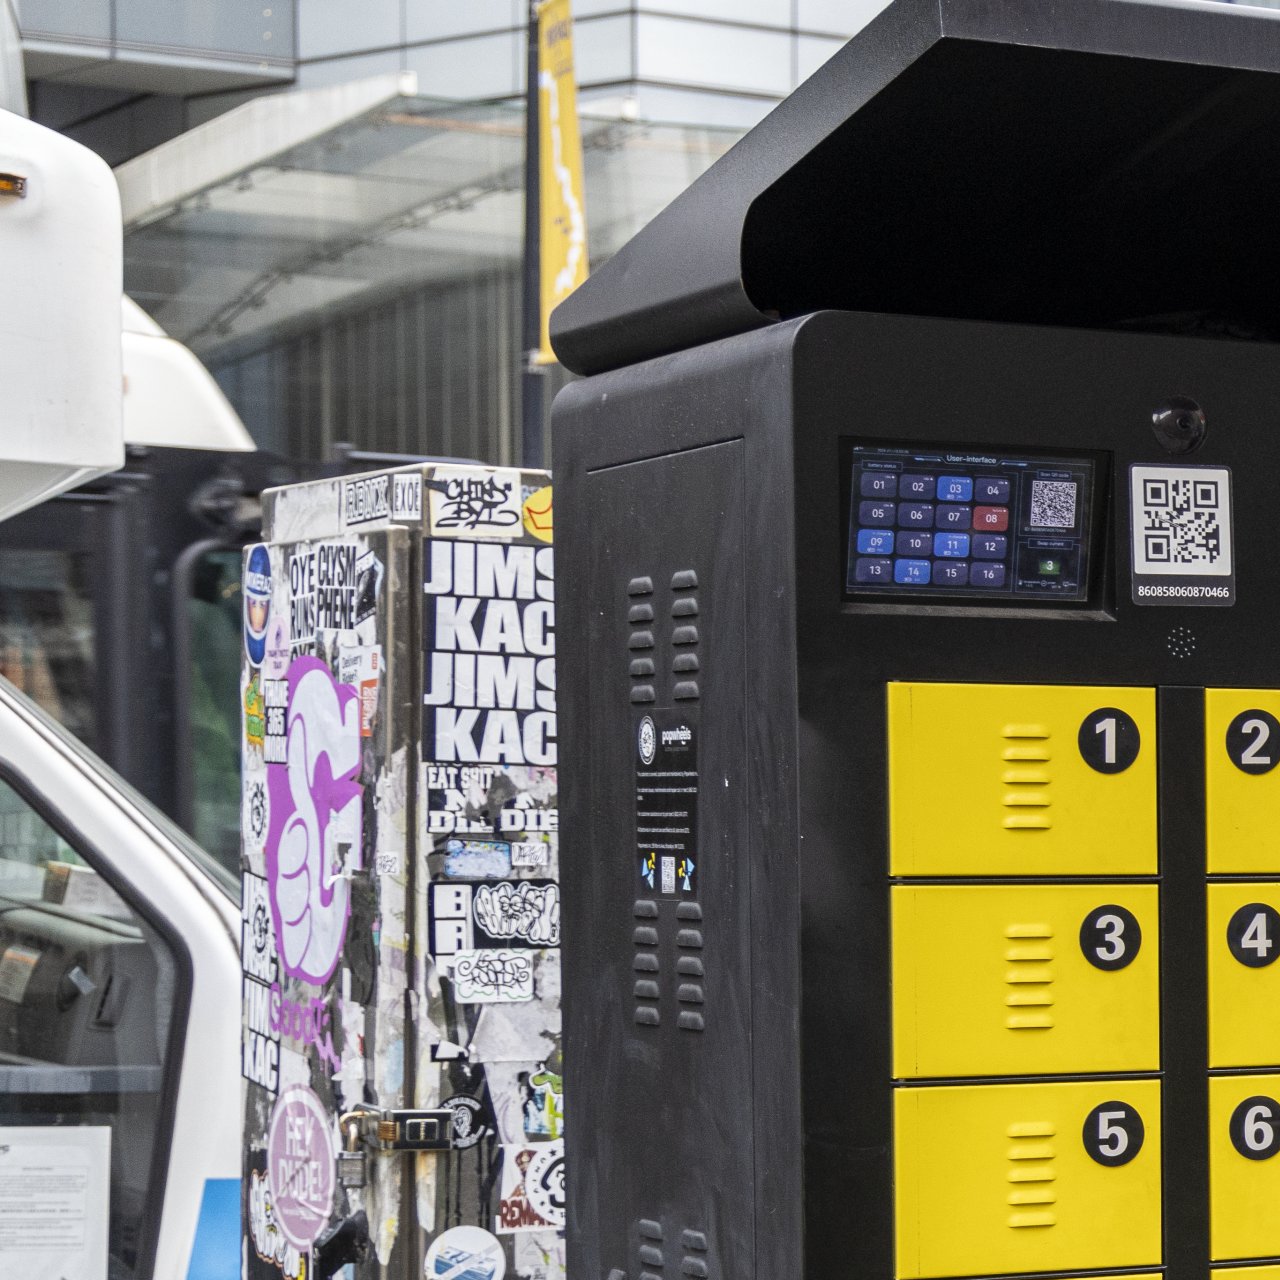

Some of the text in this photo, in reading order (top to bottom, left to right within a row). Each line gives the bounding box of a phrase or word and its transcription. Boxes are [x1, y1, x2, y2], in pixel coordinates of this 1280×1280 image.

[947, 455, 997, 464] User-interface
[873, 481, 885, 489] 01
[912, 483, 924, 491] 02
[950, 484, 961, 493] 03
[987, 486, 999, 495] 04
[872, 509, 884, 518] 05
[911, 511, 923, 520] 06
[948, 513, 960, 521] 07
[985, 514, 997, 523] 08
[871, 538, 882, 546] 09
[910, 539, 921, 548] 10
[947, 541, 958, 549] 11
[985, 543, 996, 551] 12
[870, 566, 881, 574] 13
[1046, 561, 1054, 570] 3
[291, 554, 315, 597] OYE
[908, 567, 919, 576] 14
[946, 569, 957, 578] 15
[984, 570, 995, 579] 16
[1138, 586, 1229, 598] 860858060870466
[662, 727, 691, 745] popwheels
[1096, 719, 1118, 763] 1
[1242, 719, 1270, 764] 2
[428, 766, 457, 789] EAT
[1096, 915, 1125, 960] 3
[1241, 913, 1272, 957] 4
[1245, 1106, 1273, 1150] 6
[286, 1115, 315, 1158] HEY
[1099, 1111, 1128, 1156] 5
